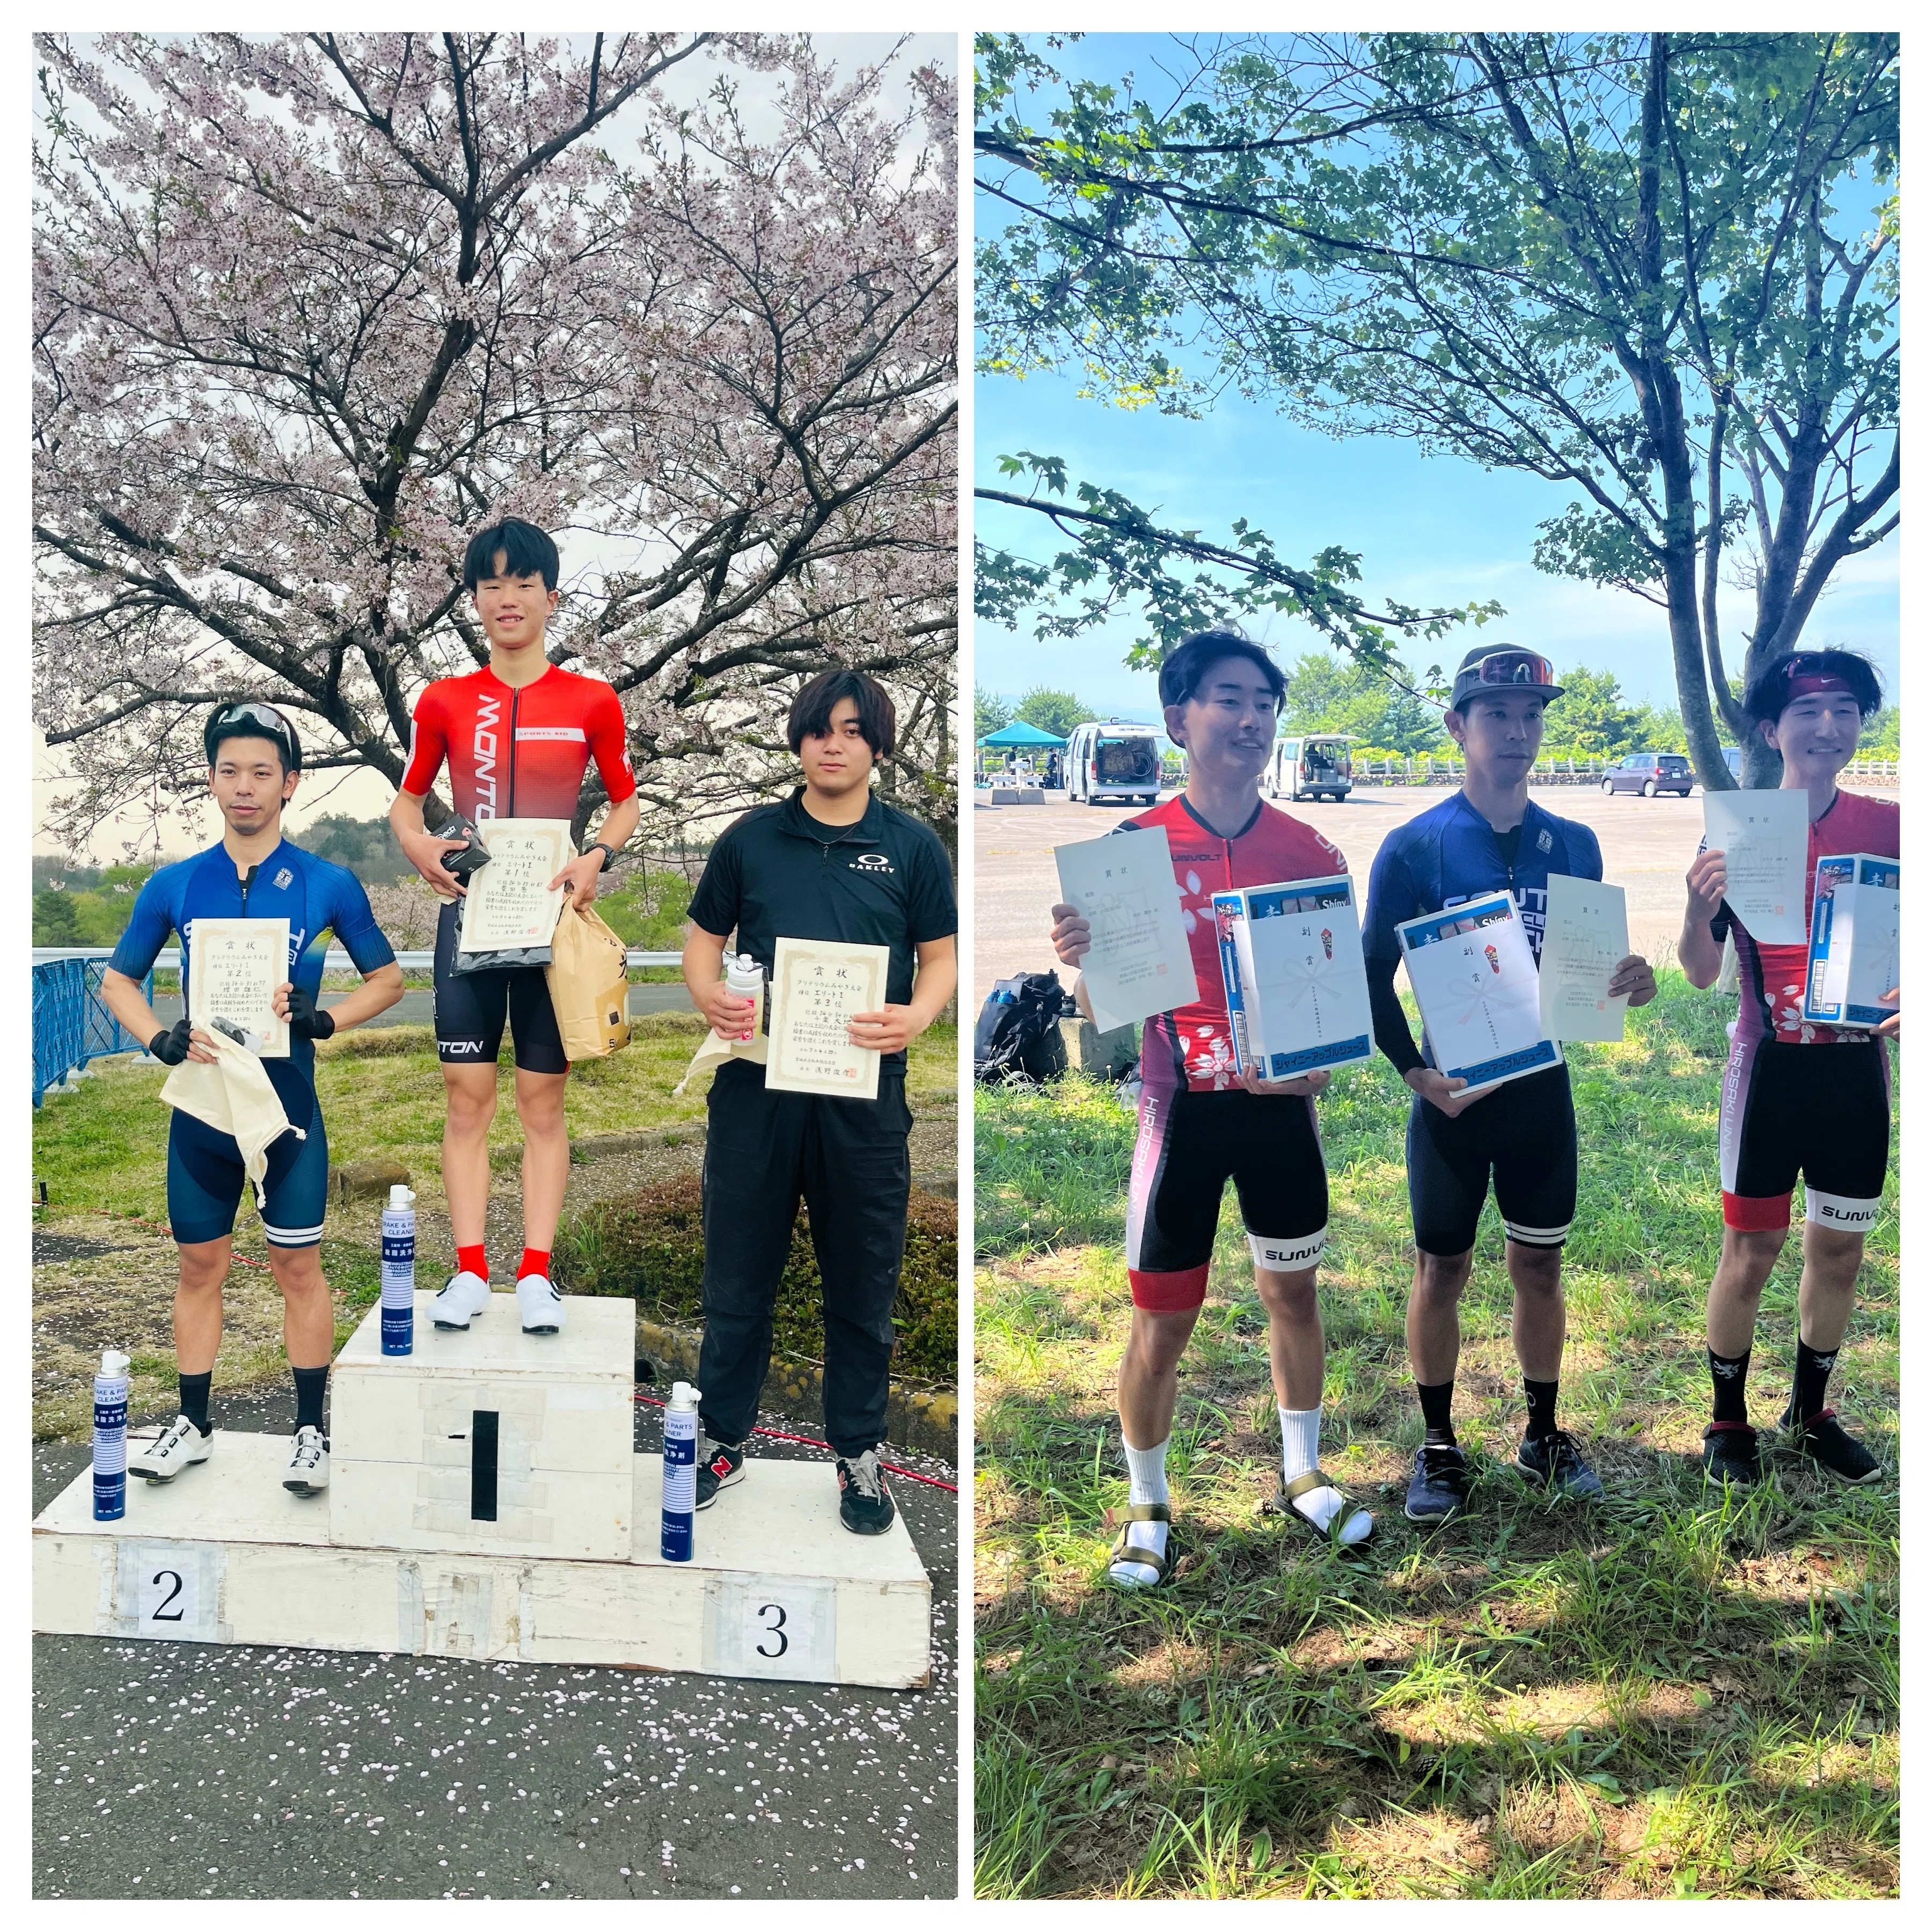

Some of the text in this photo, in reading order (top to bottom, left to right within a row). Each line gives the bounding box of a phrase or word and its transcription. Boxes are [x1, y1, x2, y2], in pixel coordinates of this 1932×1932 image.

[506, 840, 535, 850] 賞状
[849, 863, 895, 873] OAKLEY
[1322, 899, 1347, 910] Shiny
[1482, 916, 1509, 927] Shiny
[225, 941, 255, 950] 賞状
[814, 965, 848, 978] 賞状
[797, 979, 862, 992] クリテリウムみやぎ大会
[814, 999, 841, 1008] 第3位
[794, 1021, 846, 1030] あなたは上記の大会にお
[1275, 1041, 1366, 1070] シャイニーアップルジュース
[1452, 1048, 1550, 1080] イニーアップルジュース
[1723, 1042, 1746, 1159] HIROSAKI UNIV
[1134, 1096, 1159, 1178] HIROSAKI
[1821, 1206, 1878, 1221] SUNV
[1265, 1238, 1326, 1261] SUNV
[665, 1429, 681, 1437] ANER
[665, 1448, 685, 1459] 洗浄剤
[711, 1455, 733, 1480] N
[152, 1570, 184, 1621] 2
[756, 1604, 788, 1658] 3
